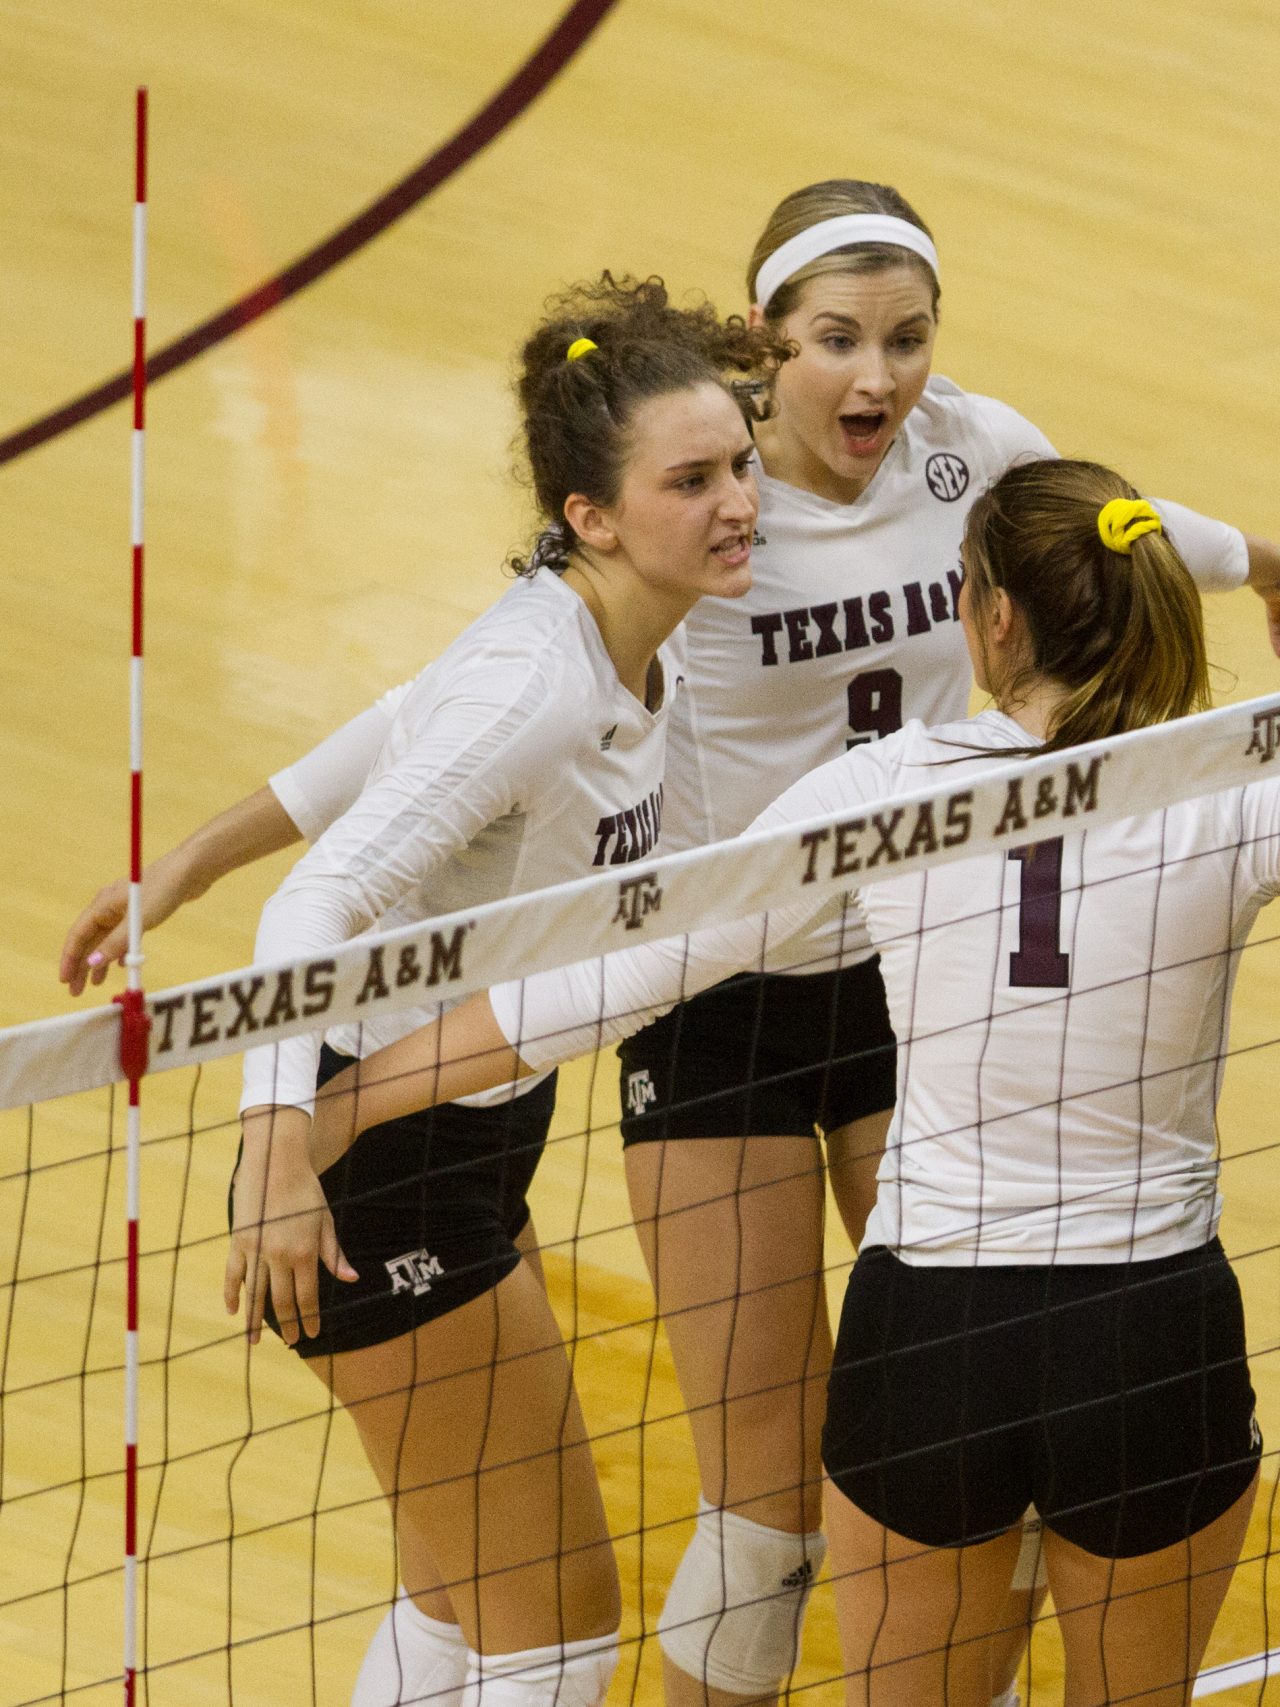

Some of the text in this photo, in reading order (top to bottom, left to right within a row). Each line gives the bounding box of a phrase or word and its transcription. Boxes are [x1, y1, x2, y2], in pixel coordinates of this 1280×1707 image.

[927, 454, 969, 500] SEC
[751, 590, 895, 666] TEXAS
[846, 667, 903, 751] 9
[800, 756, 1102, 886] TEXAS A&M
[1007, 834, 1070, 989] 1
[153, 928, 470, 1055] TEXAS A&M
